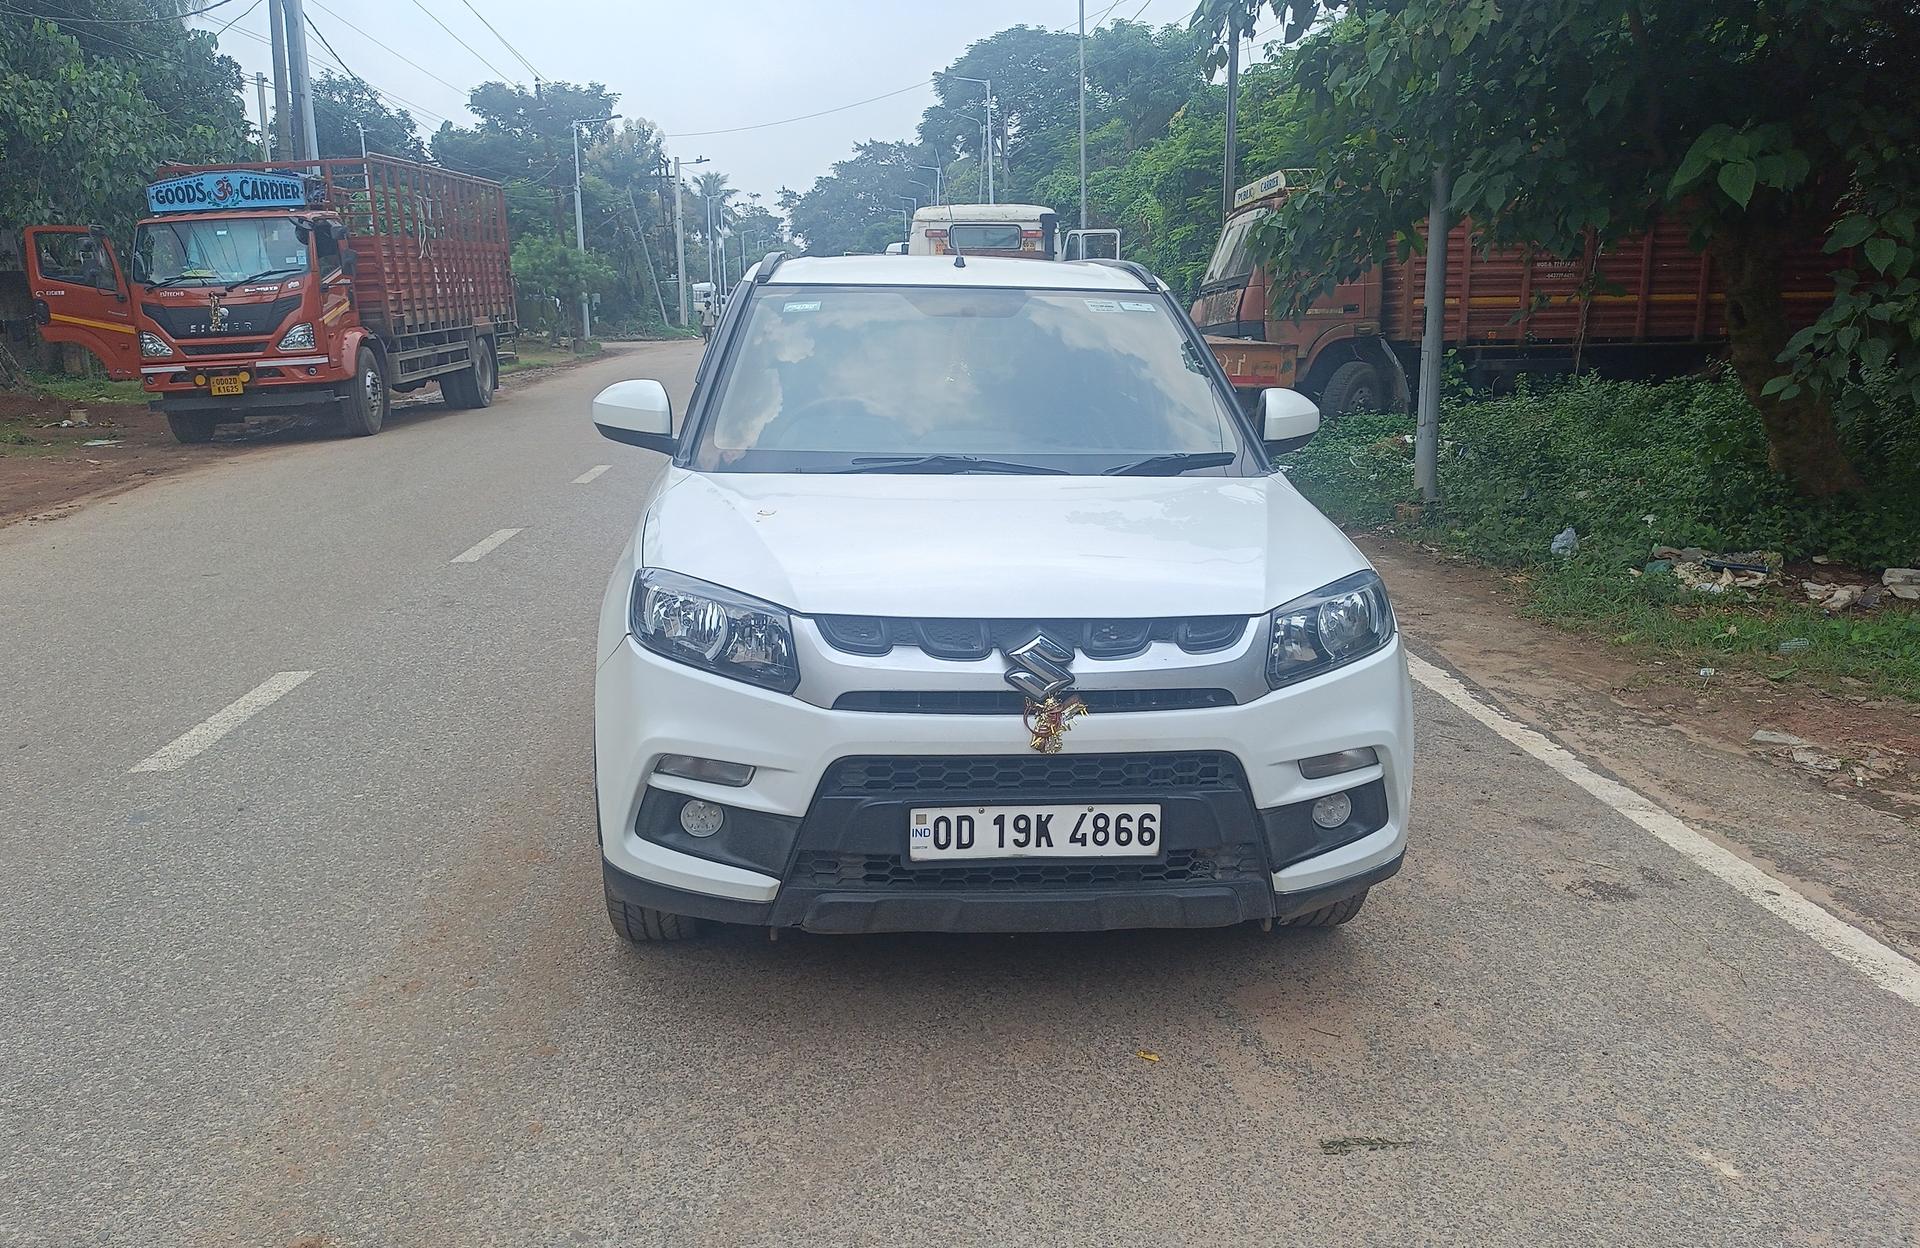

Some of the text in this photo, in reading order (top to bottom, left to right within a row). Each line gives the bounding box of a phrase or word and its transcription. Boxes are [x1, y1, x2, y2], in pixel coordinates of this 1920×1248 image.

[155, 182, 207, 205] GOODS
[239, 179, 300, 200] CARRIER
[912, 828, 931, 838] IND
[933, 812, 1157, 850] OD 19K 4866
